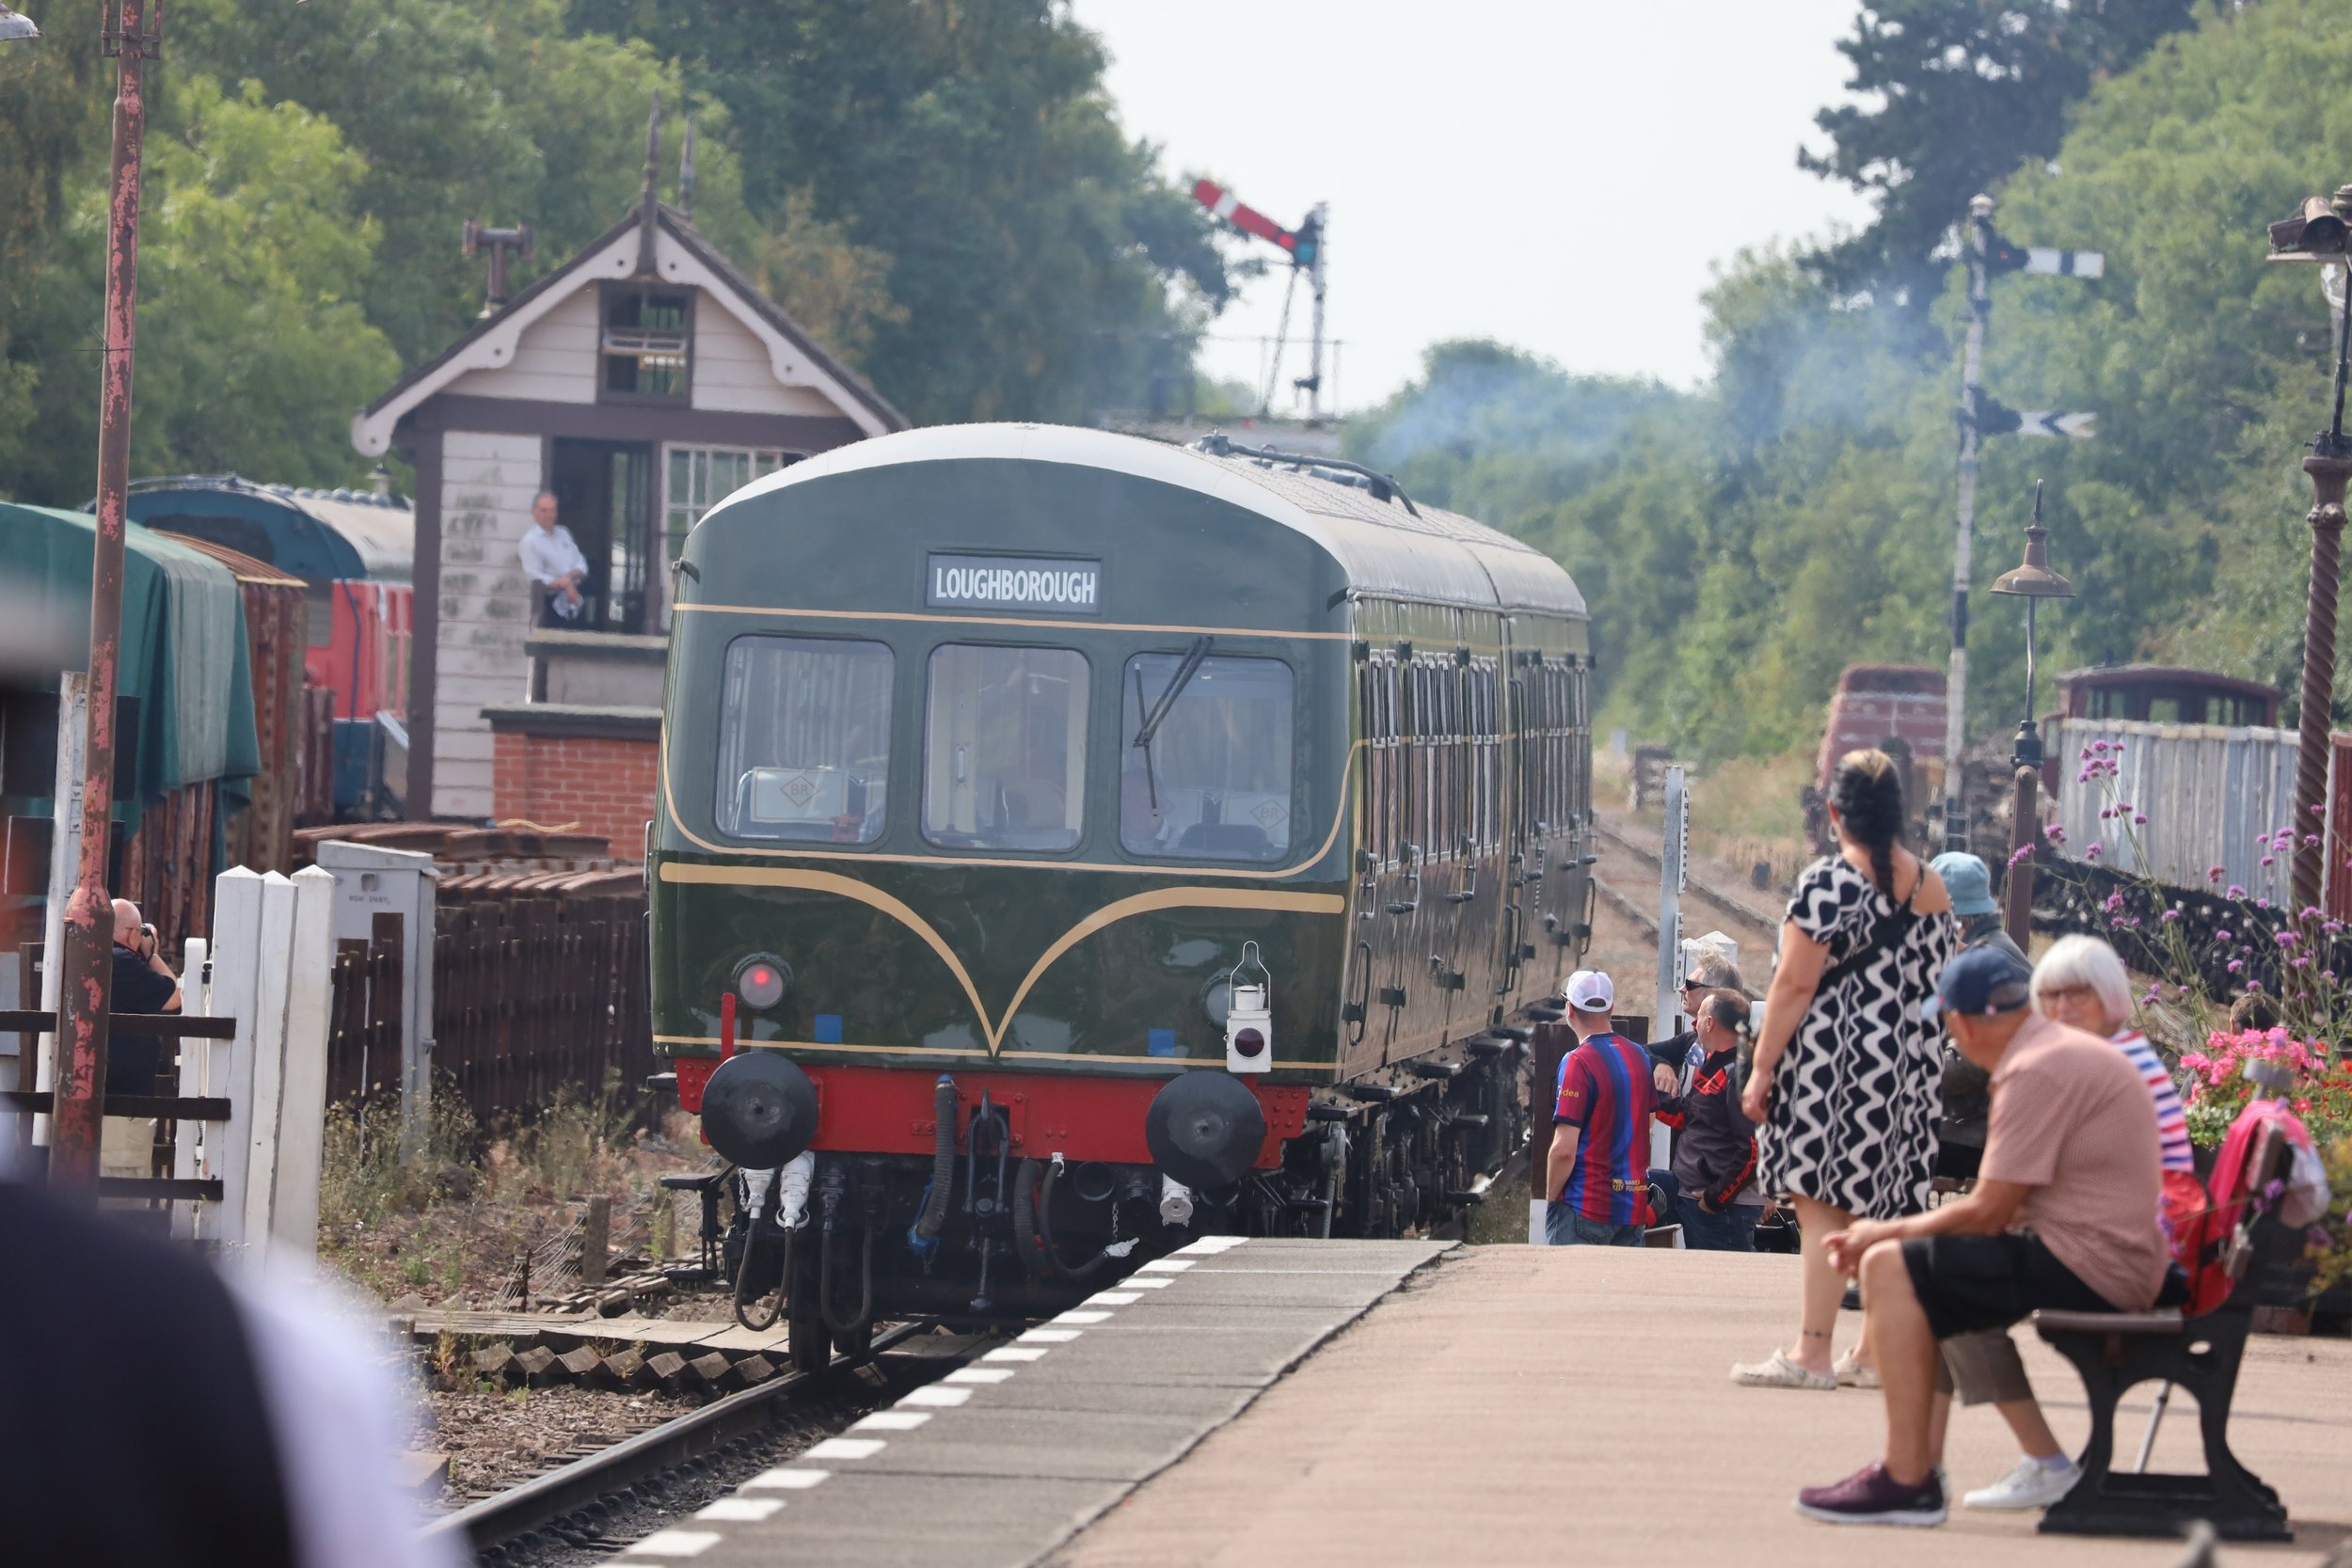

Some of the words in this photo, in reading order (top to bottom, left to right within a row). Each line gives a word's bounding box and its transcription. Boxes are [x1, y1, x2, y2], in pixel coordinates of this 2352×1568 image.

[935, 567, 1095, 604] LOUGHBOROUGH
[790, 784, 809, 796] BR
[1260, 807, 1279, 819] BR
